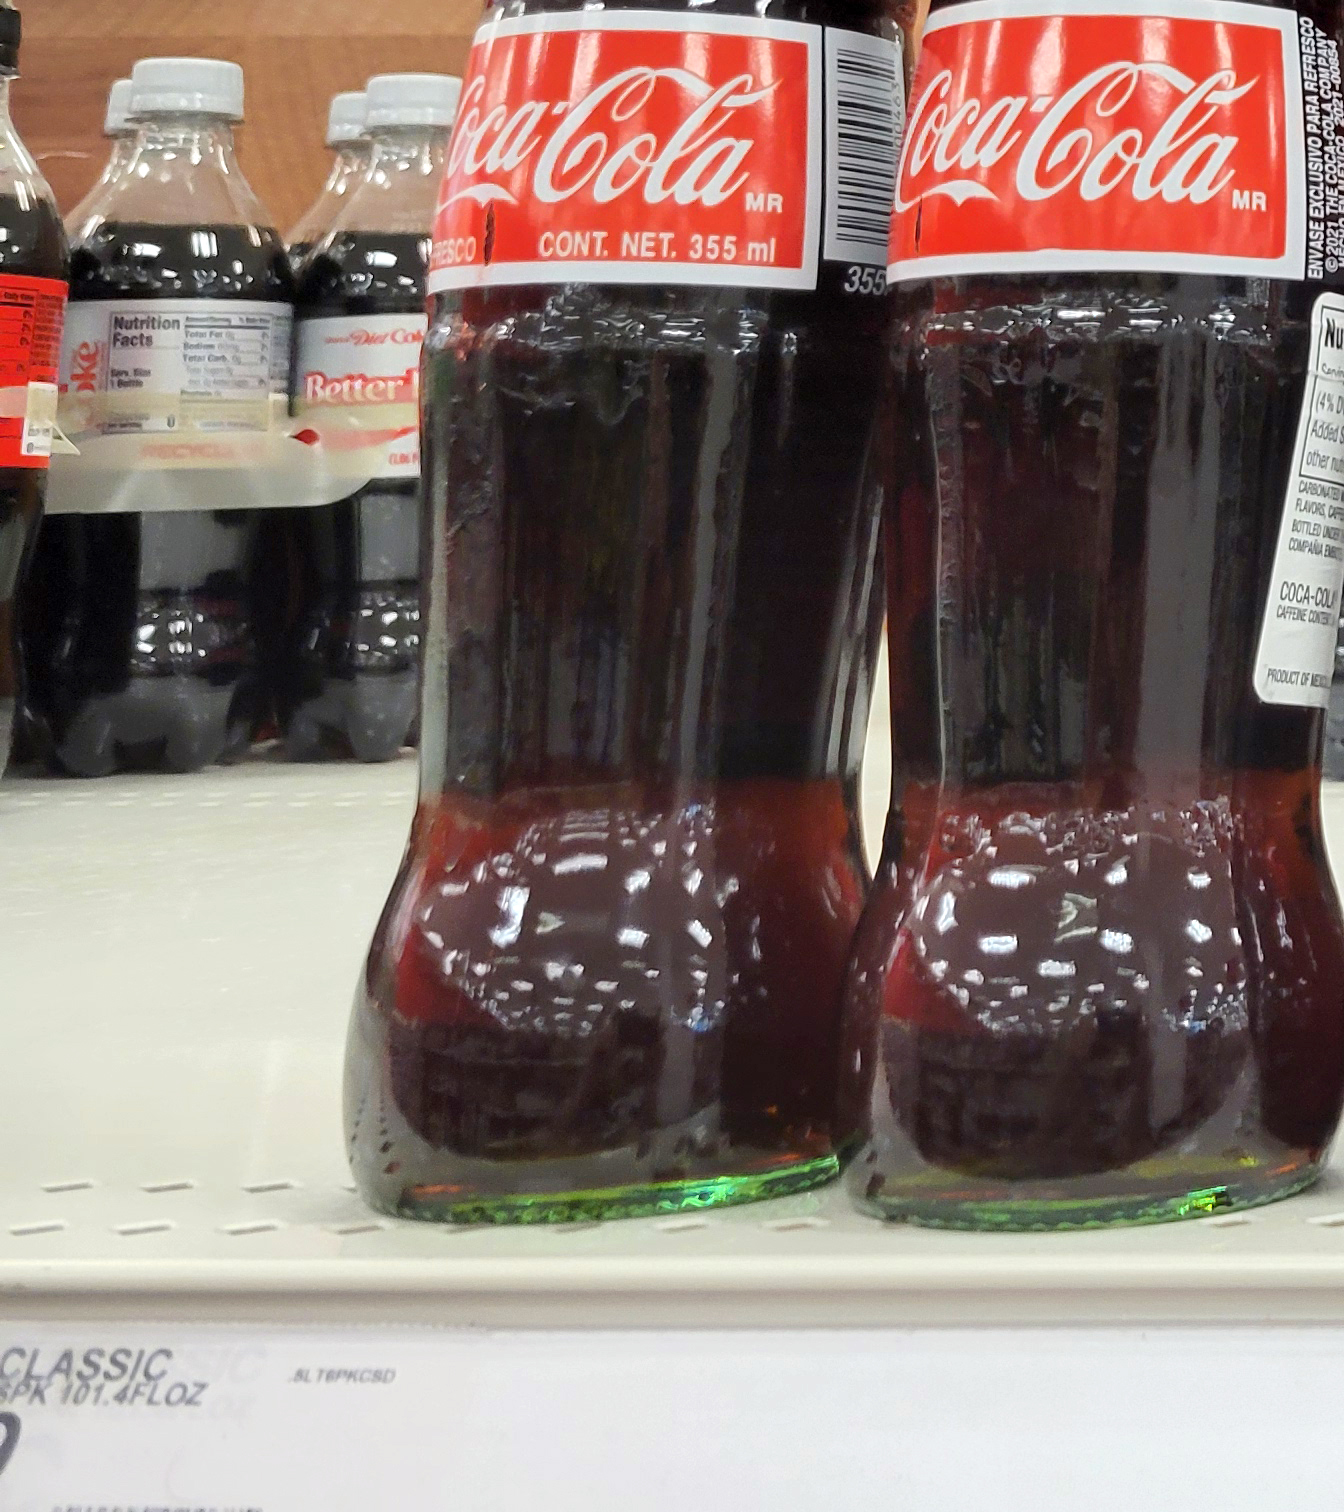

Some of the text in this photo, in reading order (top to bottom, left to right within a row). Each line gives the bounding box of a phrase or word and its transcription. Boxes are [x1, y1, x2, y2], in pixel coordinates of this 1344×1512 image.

[1315, 27, 1333, 100] COMPANY
[895, 60, 1261, 214] Coca-Cola
[1299, 16, 1325, 279] ENVASE EXCLUSIVO PARA REFRESCO
[1321, 103, 1338, 185] COCA-COLA
[746, 190, 783, 214] MR
[1232, 190, 1267, 212] MR
[1325, 186, 1339, 215] THE
[539, 231, 609, 258] CONT.
[621, 231, 676, 259] NET.
[689, 234, 738, 261] 355
[747, 235, 776, 263] ml
[113, 316, 181, 331] Nutrition
[113, 333, 153, 348] Facts
[305, 372, 405, 405] Better
[1310, 419, 1340, 444] Added
[1306, 449, 1330, 472] other
[1295, 498, 1327, 520] FLAVORS,
[1291, 519, 1322, 538] BOTTLED
[1276, 604, 1307, 623] CAFFEINE
[1267, 667, 1311, 687] PRODUCT OF
[0, 1346, 174, 1383] CLASSIC
[60, 1382, 209, 1407] 101.4FLOZ
